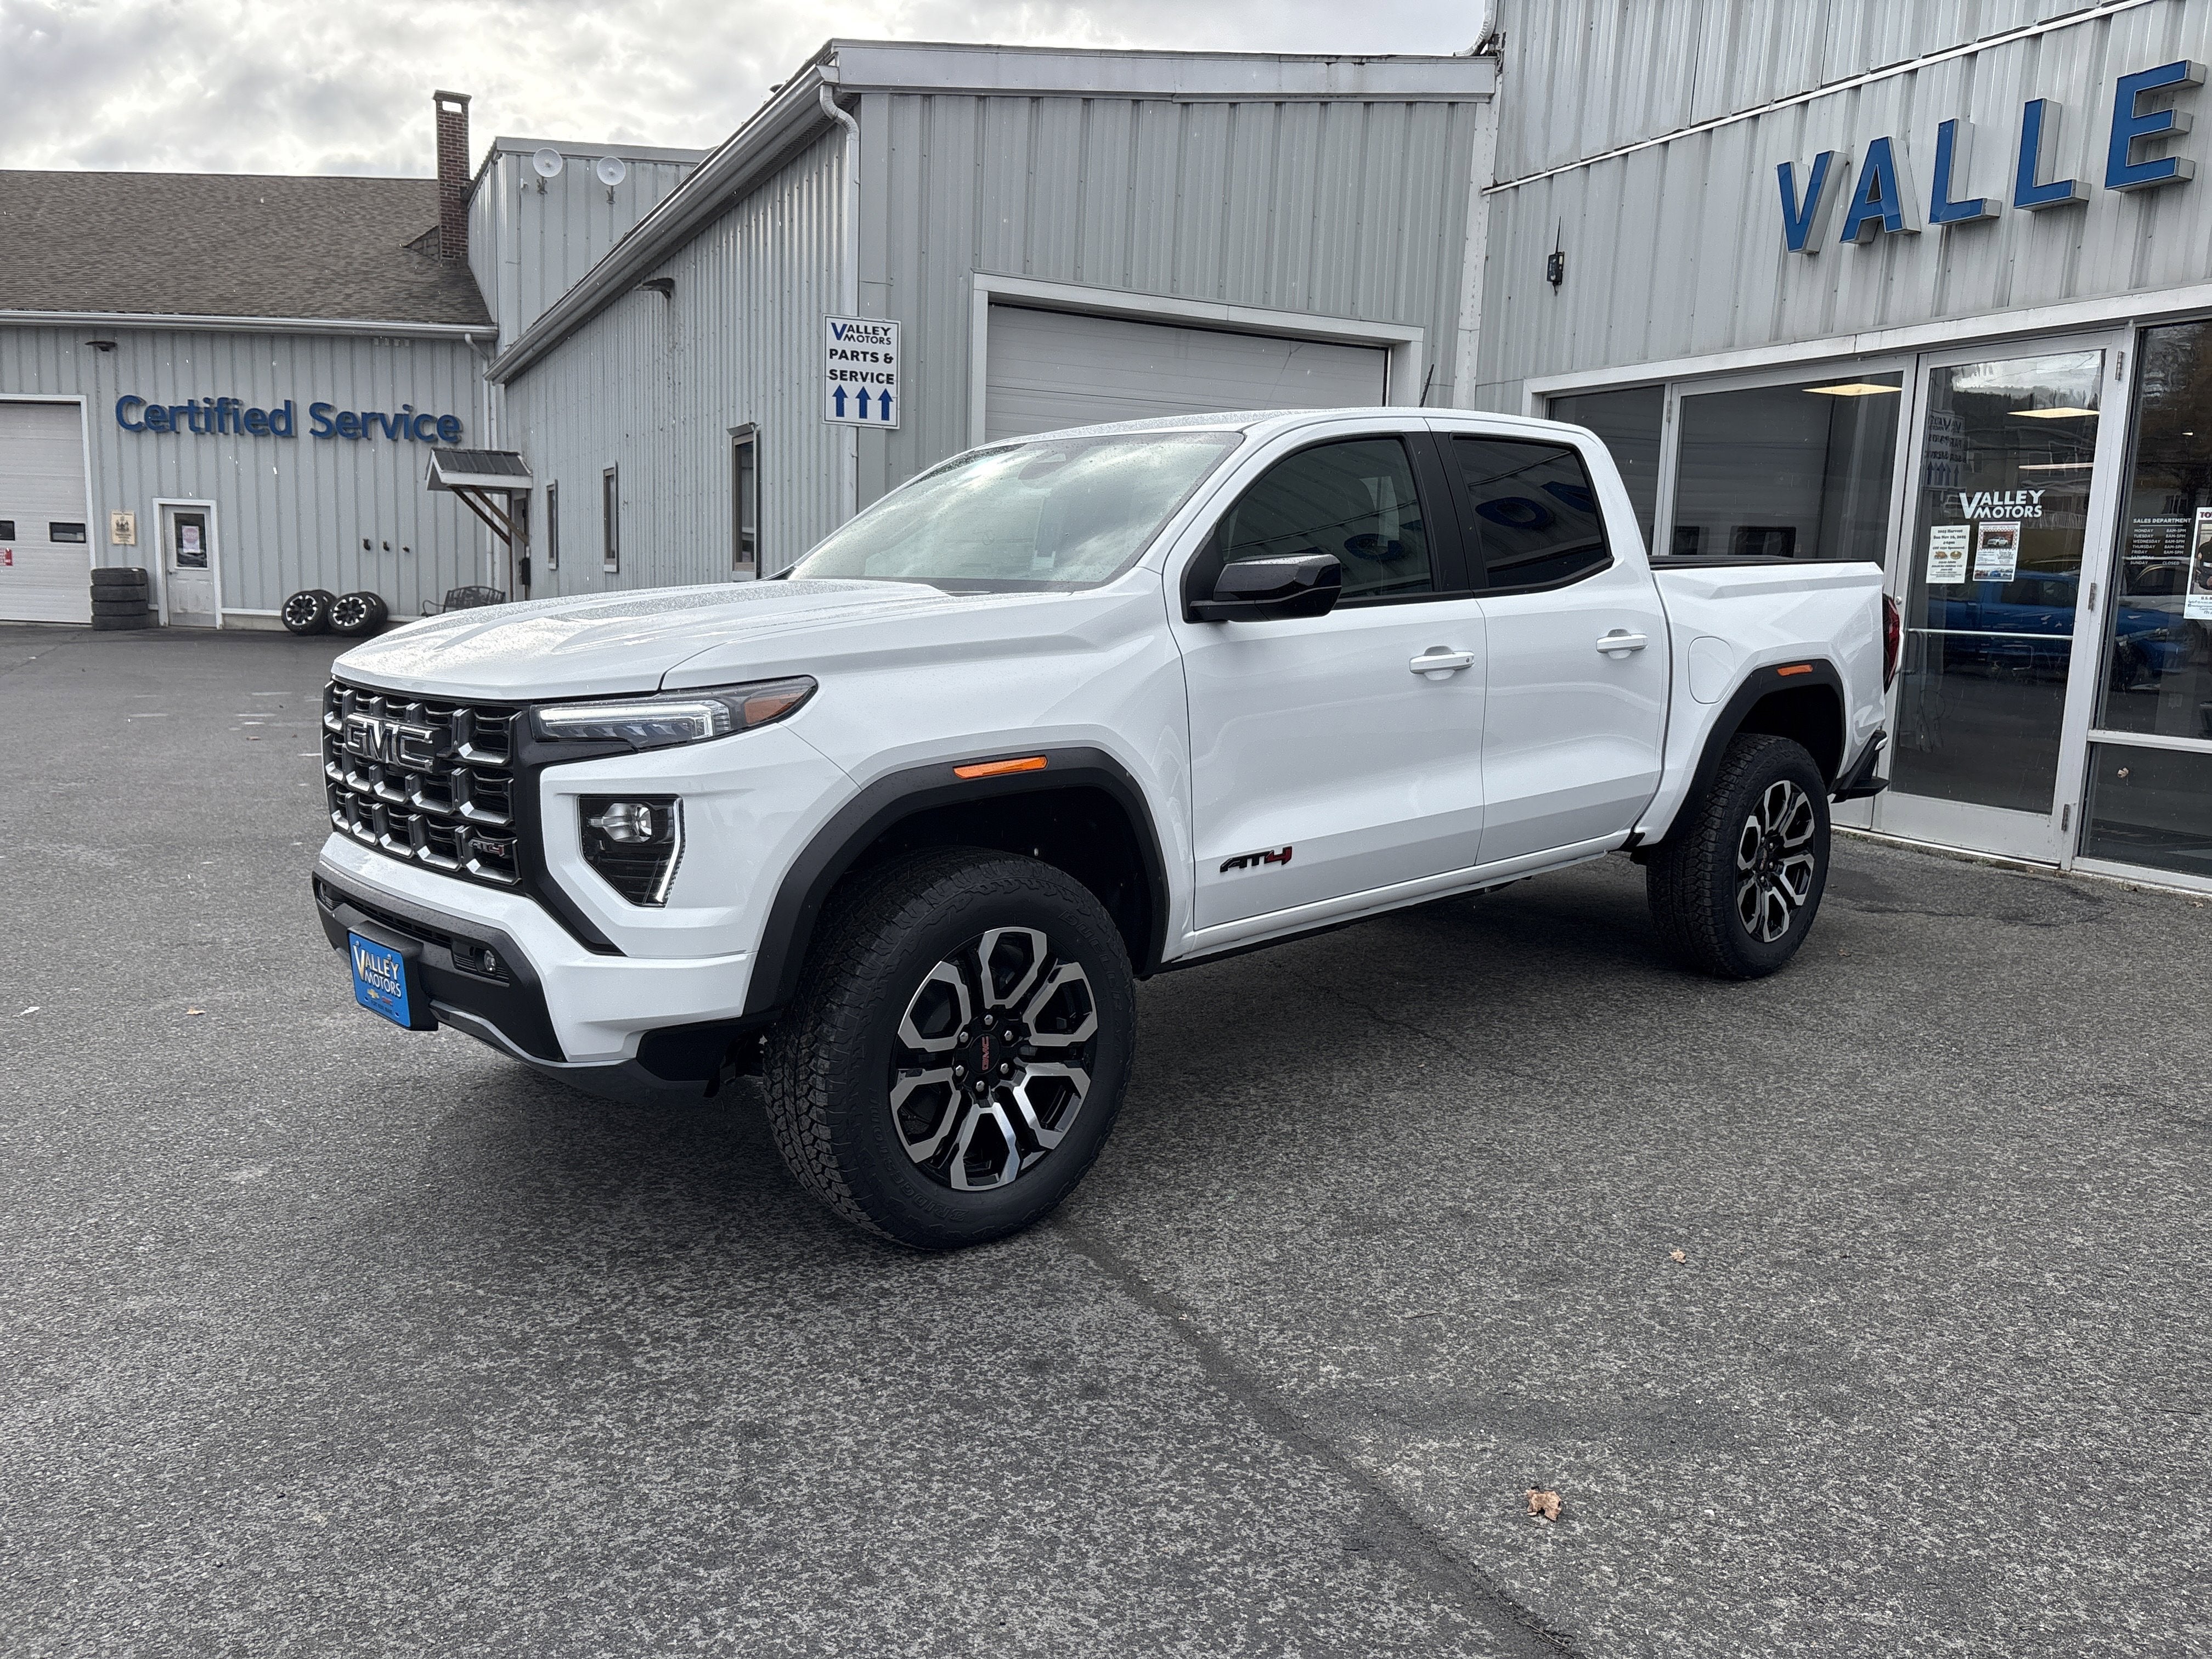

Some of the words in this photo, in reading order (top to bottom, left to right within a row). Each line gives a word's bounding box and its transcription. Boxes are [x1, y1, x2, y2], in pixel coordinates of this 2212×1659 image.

[1776, 59, 2206, 255] VALLE
[831, 322, 891, 341] VALLEY
[843, 334, 891, 346] MOTORS
[829, 348, 879, 363] PARTS
[883, 353, 894, 364] &
[829, 369, 895, 385] SERVICE
[115, 394, 294, 438] Certified
[309, 402, 461, 442] Service
[1959, 489, 2046, 519] VALLEY
[1973, 505, 2042, 519] MOTORS
[344, 713, 433, 774] GMC
[468, 839, 505, 857] AT4
[1219, 845, 1293, 873] AT4
[353, 945, 399, 981] VALLEY
[364, 971, 402, 997] MOTORS
[981, 1036, 990, 1070] GMC
